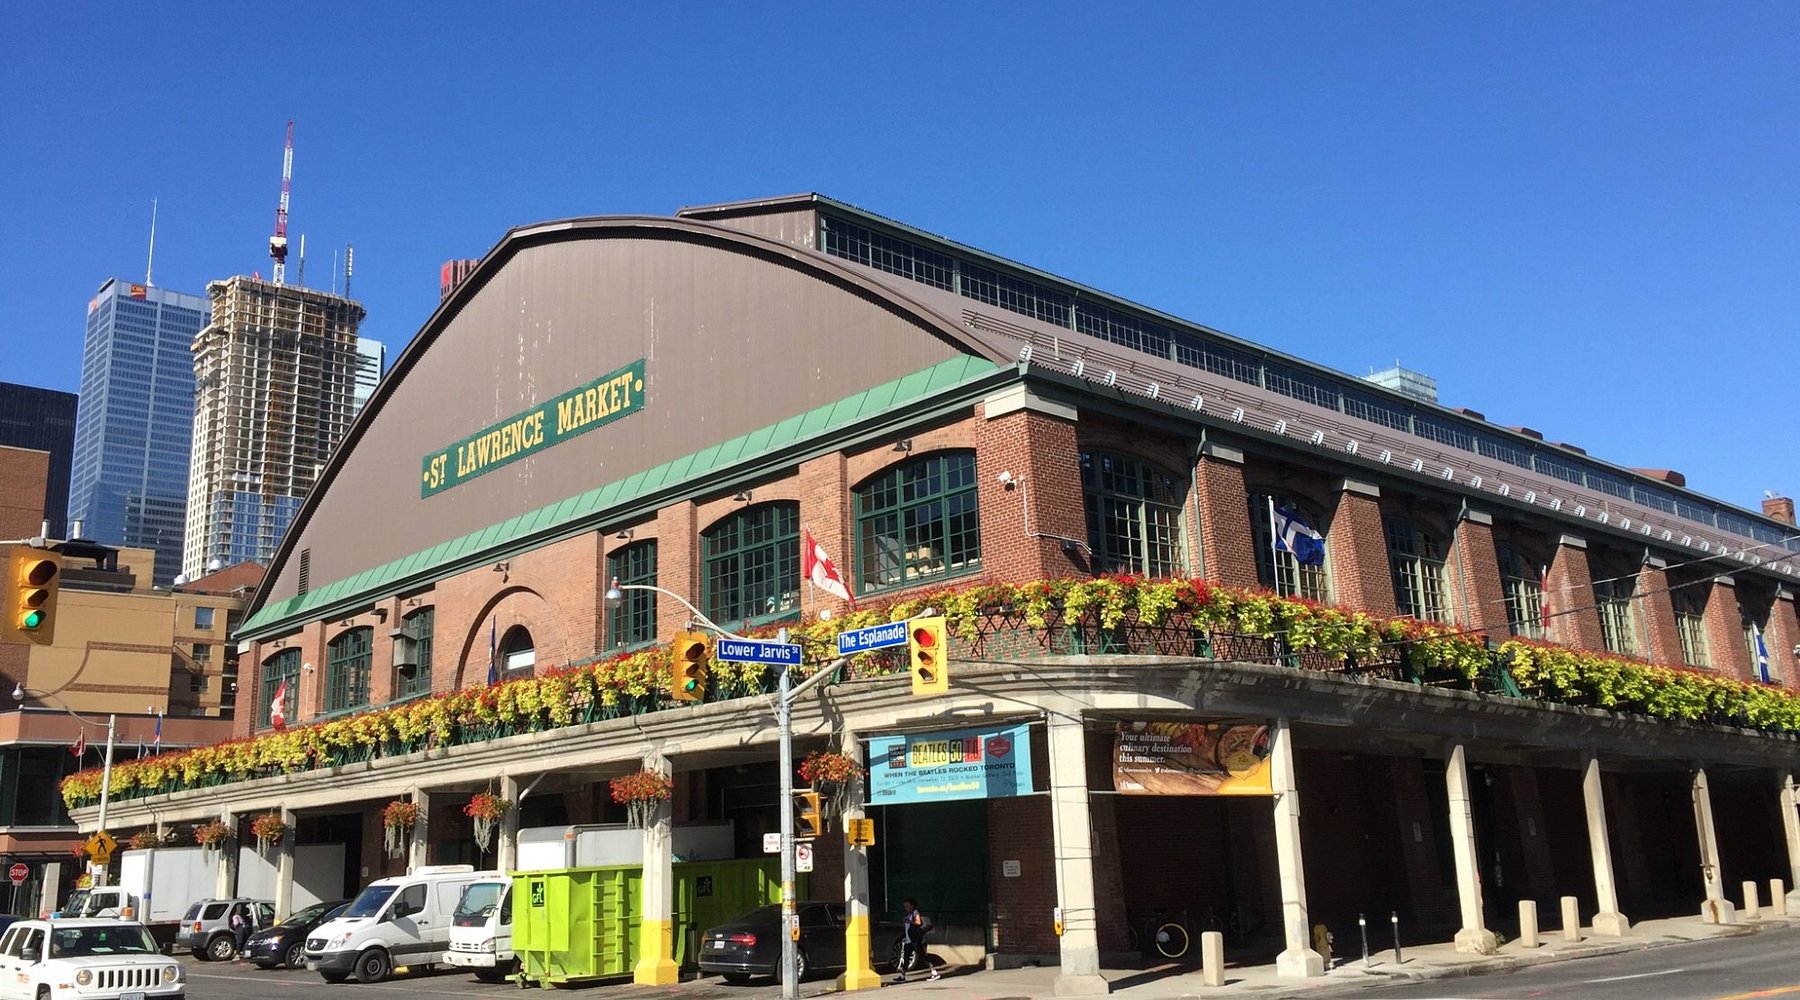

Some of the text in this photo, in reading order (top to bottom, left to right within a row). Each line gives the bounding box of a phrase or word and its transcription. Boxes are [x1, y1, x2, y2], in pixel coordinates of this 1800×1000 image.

[457, 411, 544, 477] LAWRENCE
[557, 372, 633, 435] MARKET
[840, 626, 904, 649] The Esplanade
[721, 641, 755, 657] Lower
[759, 644, 791, 659] Jarvis
[1121, 732, 1171, 742] Your ultimate
[912, 740, 947, 765] BEATLES
[950, 740, 963, 762] 50
[1119, 743, 1192, 754] culinary destination
[1119, 753, 1166, 763] this summer.
[918, 768, 947, 776] BEATLES
[949, 765, 978, 773] ROCKED
[980, 762, 1016, 771] TORONTO
